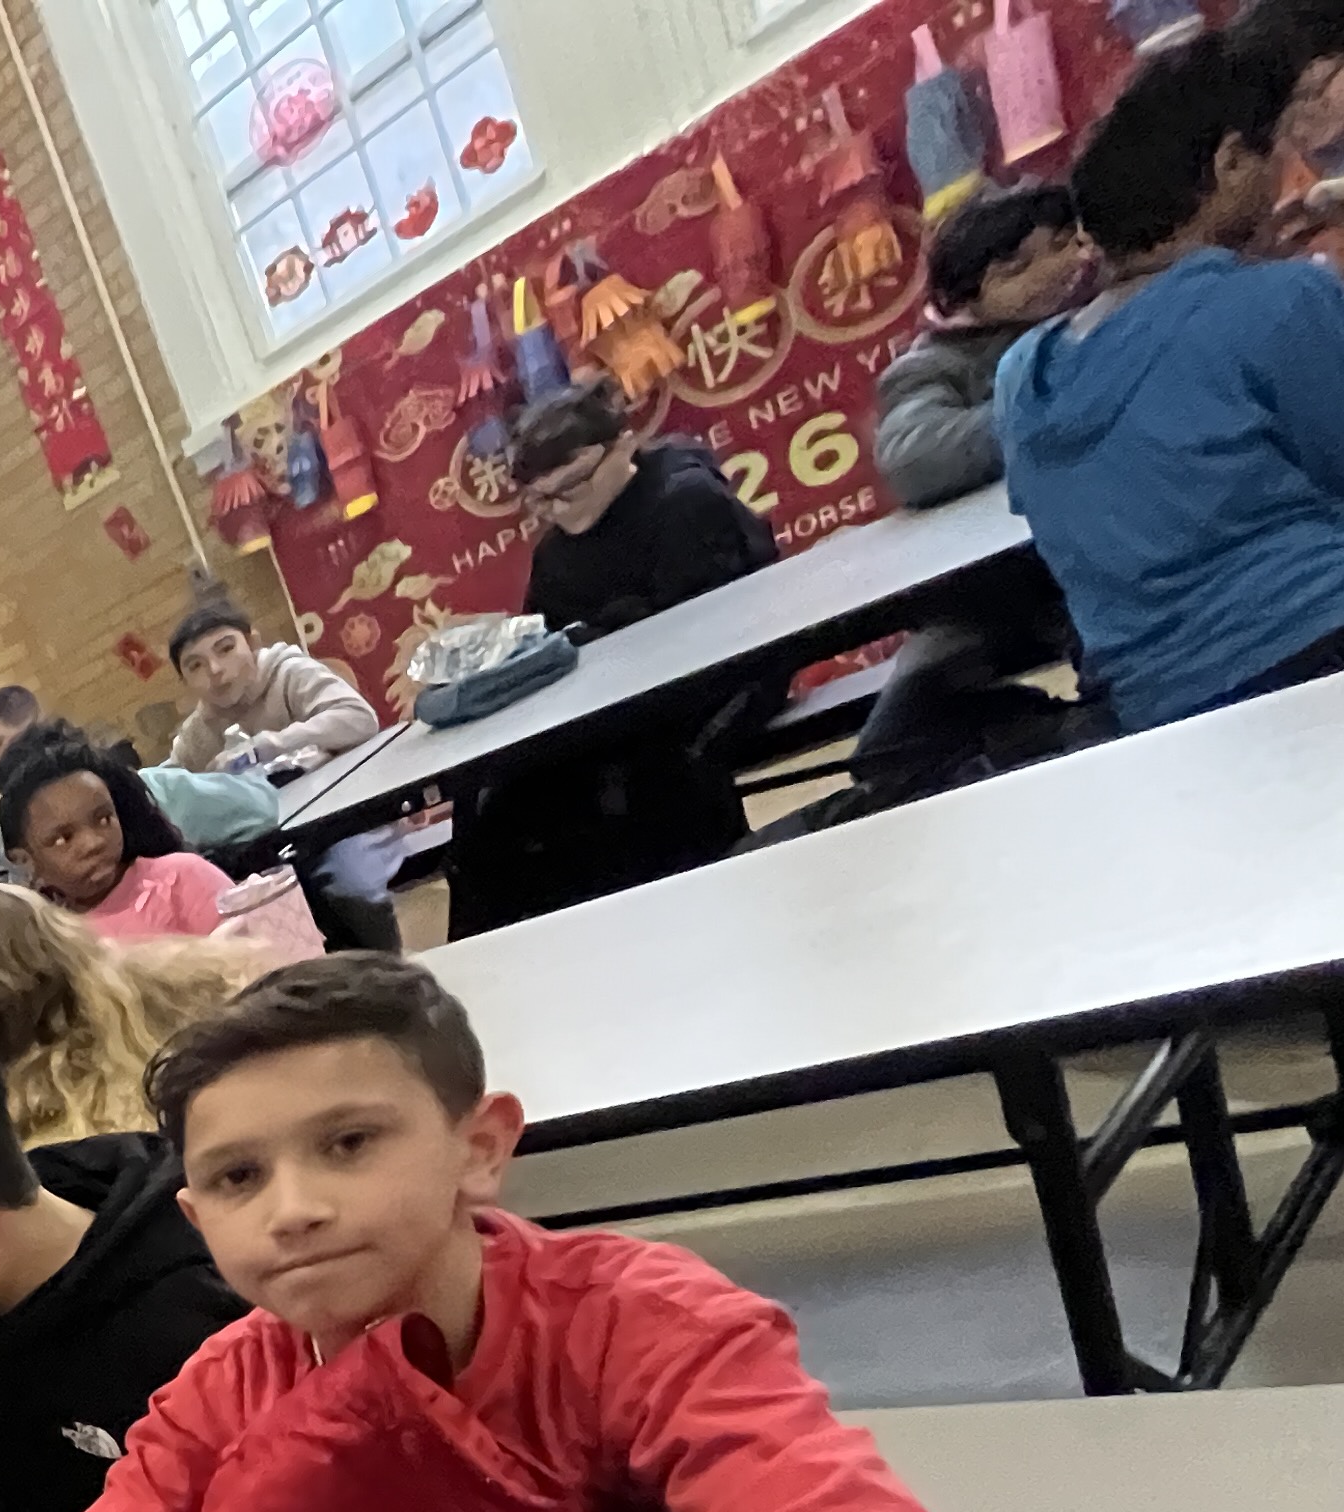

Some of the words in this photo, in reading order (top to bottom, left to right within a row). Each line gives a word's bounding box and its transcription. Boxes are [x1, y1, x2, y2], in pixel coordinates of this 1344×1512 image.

[687, 305, 775, 390] 快
[452, 514, 541, 575] HAPP
[747, 361, 841, 431] NEW
[719, 410, 860, 515] 26
